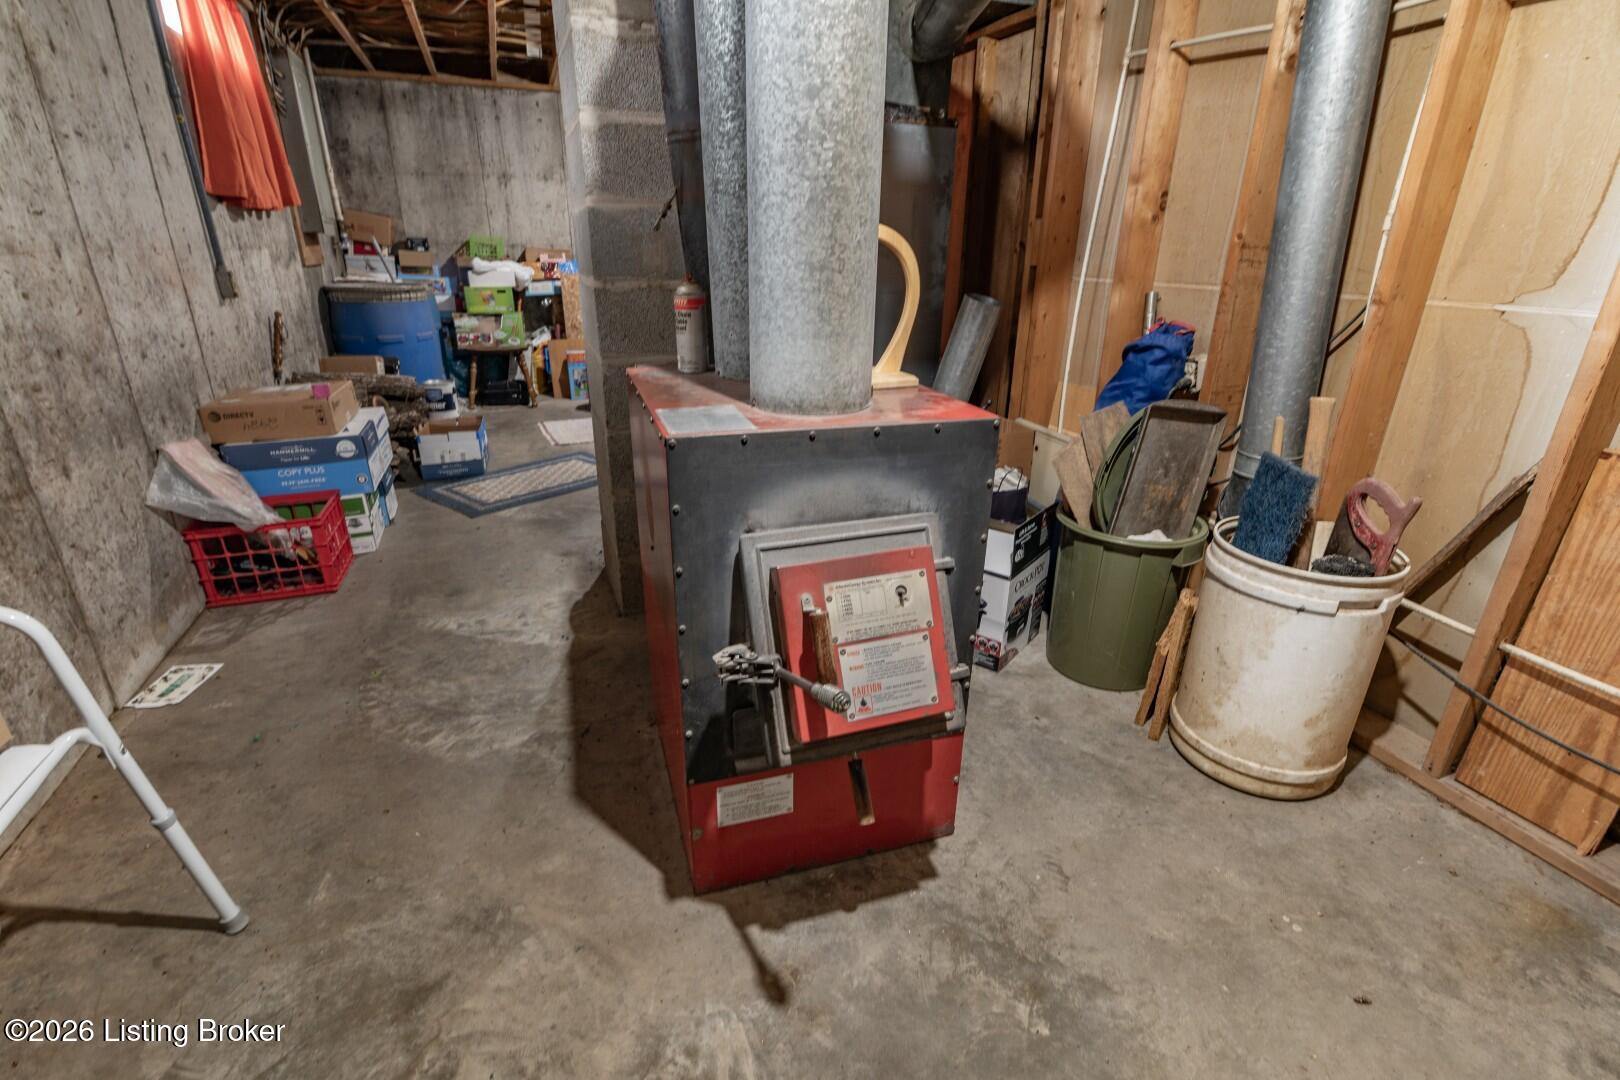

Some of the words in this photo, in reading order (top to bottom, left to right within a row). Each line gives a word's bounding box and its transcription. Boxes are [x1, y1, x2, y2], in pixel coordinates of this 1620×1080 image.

[222, 411, 254, 420] DIRECTV
[277, 468, 301, 477] COPY
[303, 465, 326, 474] PLUS
[851, 682, 882, 698] CAUTION
